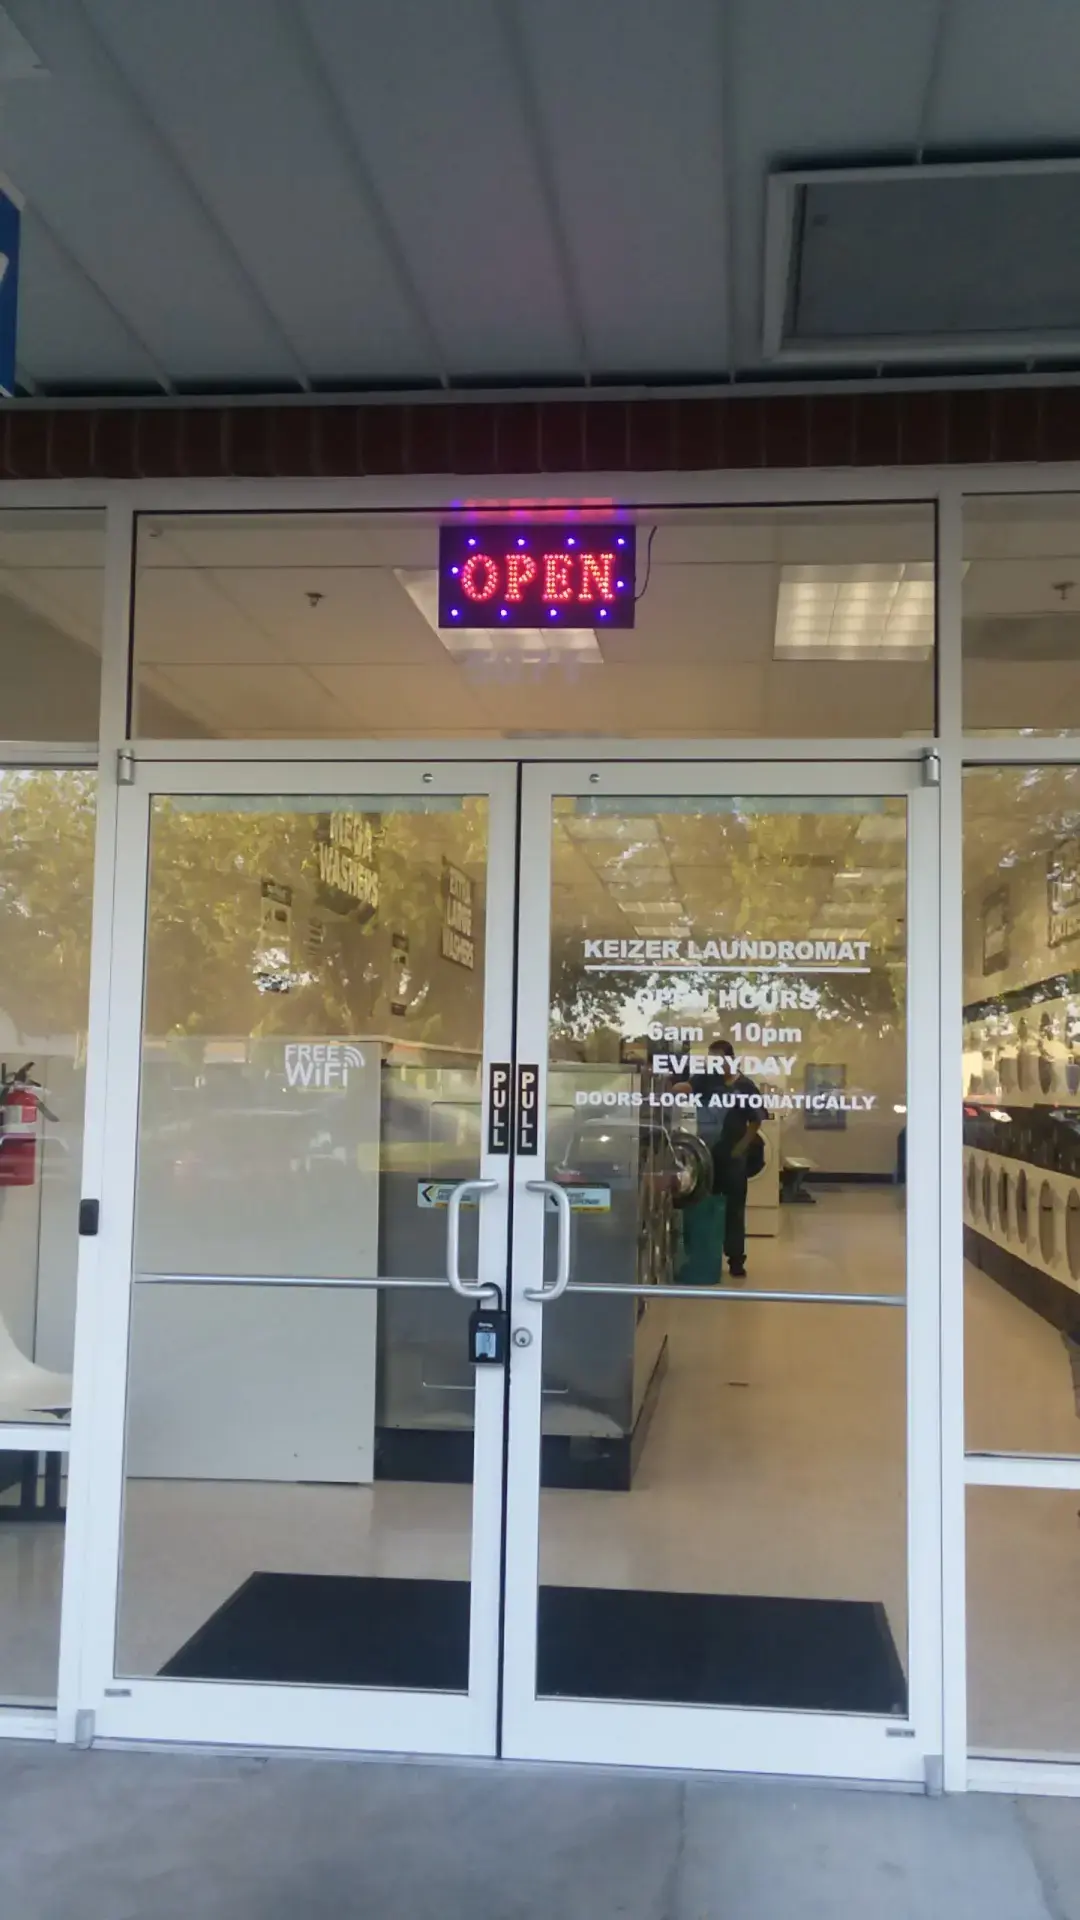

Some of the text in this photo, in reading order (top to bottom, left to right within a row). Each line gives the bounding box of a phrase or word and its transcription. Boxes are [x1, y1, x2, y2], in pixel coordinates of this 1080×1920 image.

[461, 553, 616, 601] OPEN
[319, 842, 378, 908] WASHERS
[584, 940, 871, 962] KEIZER LAUNDROMAT
[636, 989, 820, 1010] OPEN HOURS
[648, 1022, 703, 1042] 6am
[730, 1022, 802, 1045] 10pm
[284, 1044, 340, 1062] FREE
[284, 1062, 348, 1087] WiFi
[652, 1054, 797, 1077] EVERYDAY
[492, 1070, 508, 1148] PULL
[520, 1071, 536, 1149] PULL
[575, 1091, 876, 1111] DOORS LOCK AUTOMATICALLY
